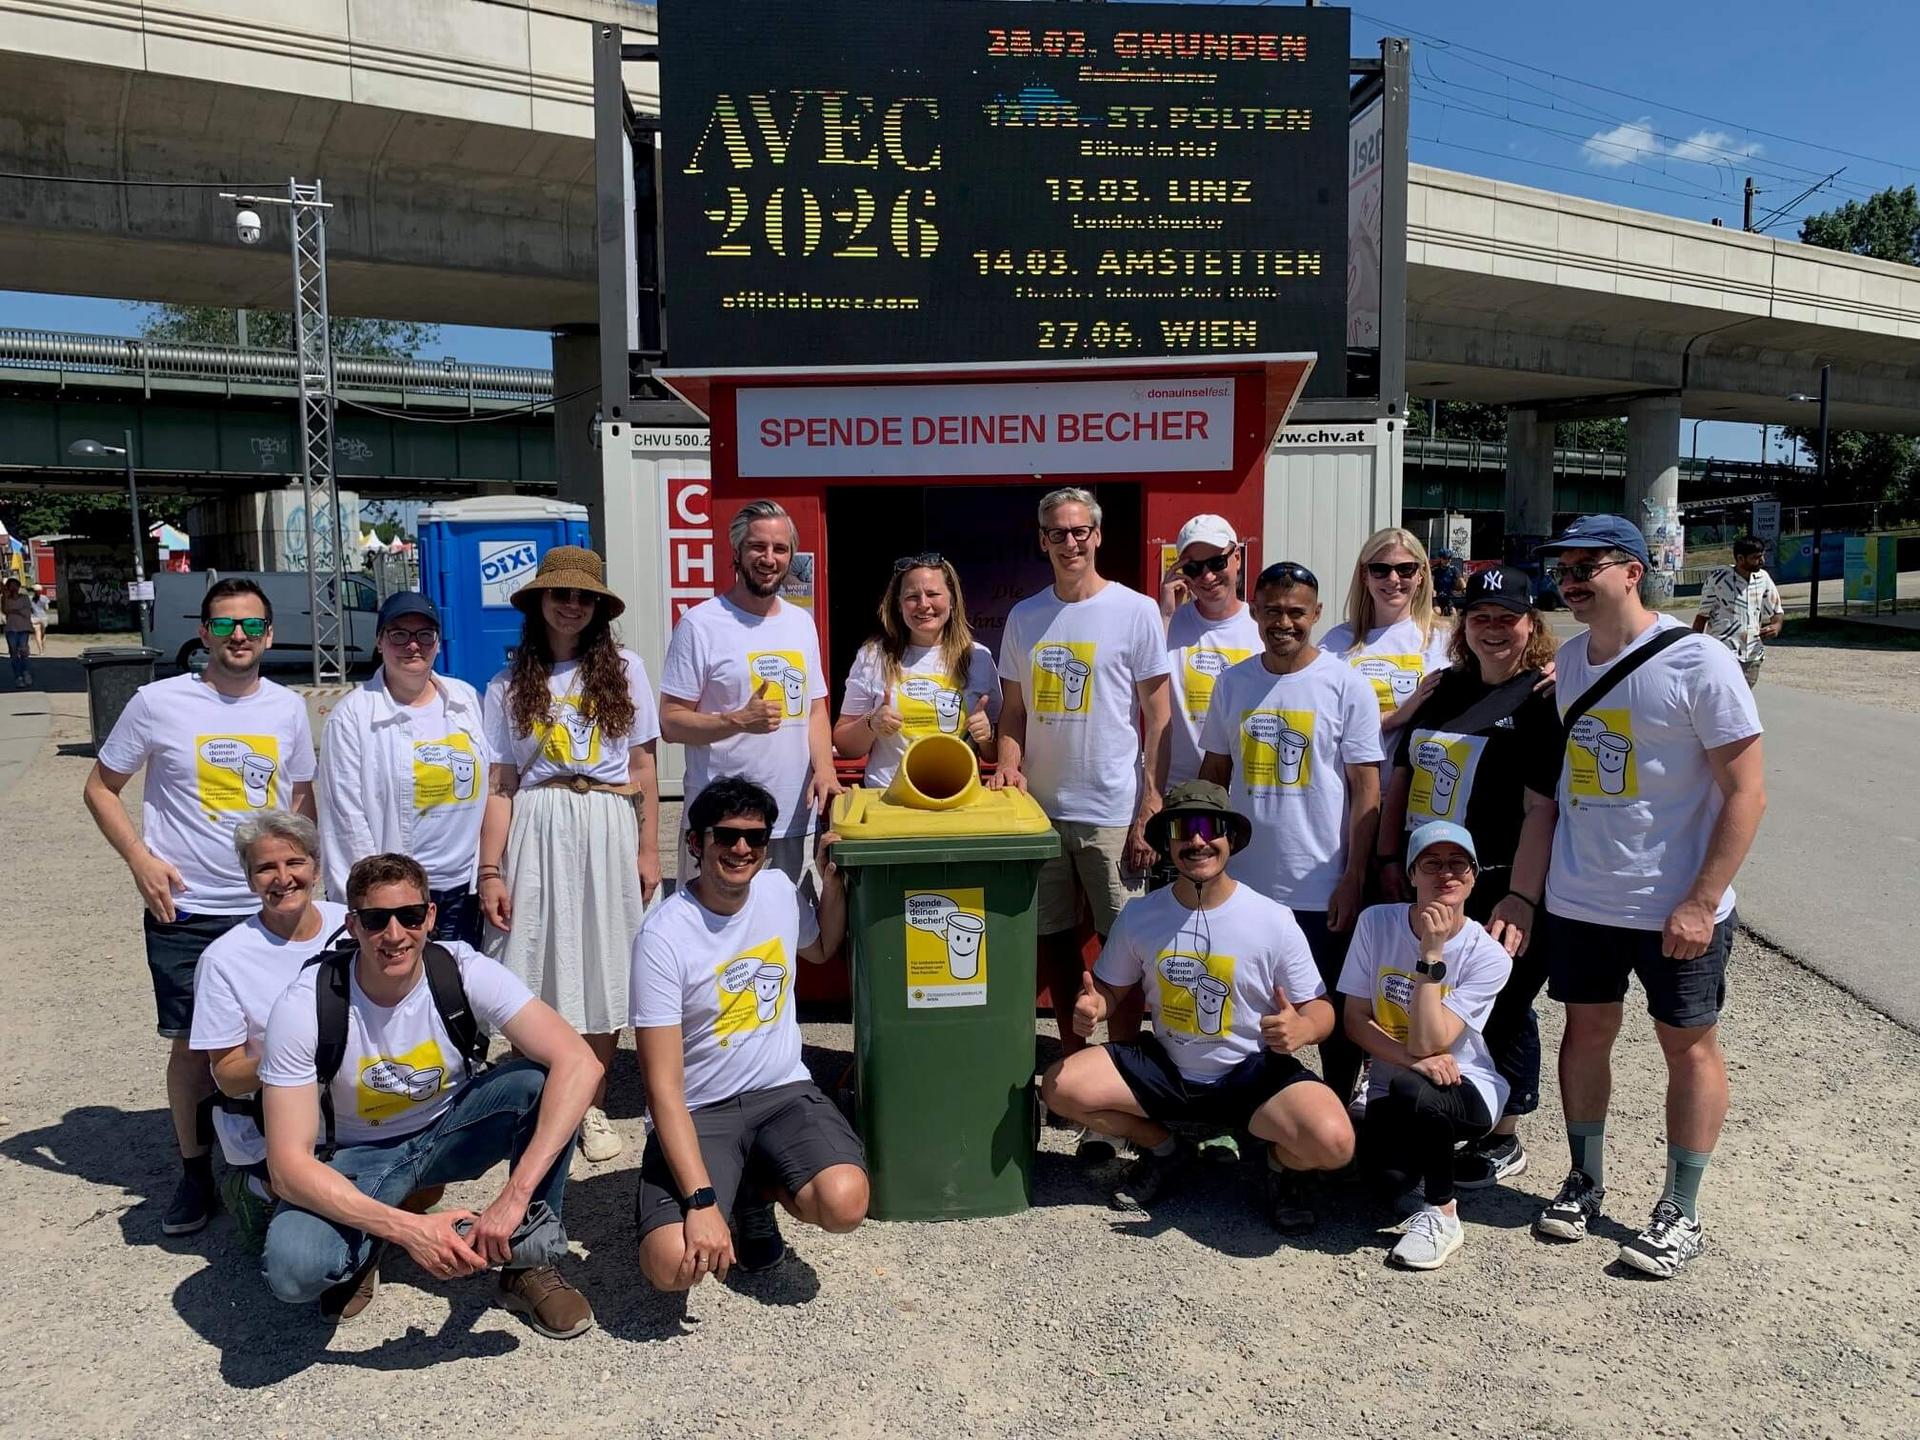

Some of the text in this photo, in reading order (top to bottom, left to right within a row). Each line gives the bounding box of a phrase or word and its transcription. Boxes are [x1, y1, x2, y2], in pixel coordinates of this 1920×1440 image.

[1114, 33, 1306, 61] GMUNDEN
[1108, 107, 1157, 127] ST.
[683, 90, 941, 173] AVEC
[1046, 180, 1251, 202] 13.03. LINZ
[705, 188, 939, 257] 2026
[973, 249, 1320, 274] 14.03. AMSTETTEN
[1039, 321, 1256, 347] 27.06. WIEN
[760, 411, 1209, 447] SPENDE DEINEN BECHER
[634, 434, 671, 446] CHVU
[676, 484, 714, 614] CH
[1251, 716, 1276, 724] Spende
[208, 742, 238, 750] Spende
[909, 900, 942, 908] Spende
[910, 908, 939, 916] deinen
[912, 916, 944, 924] Becher!
[724, 962, 748, 977] Spende
[1167, 960, 1194, 968] Spende
[726, 970, 750, 984] deinen
[728, 976, 755, 991] Becher
[1386, 976, 1414, 990] Spende
[1384, 985, 1410, 997] deinen
